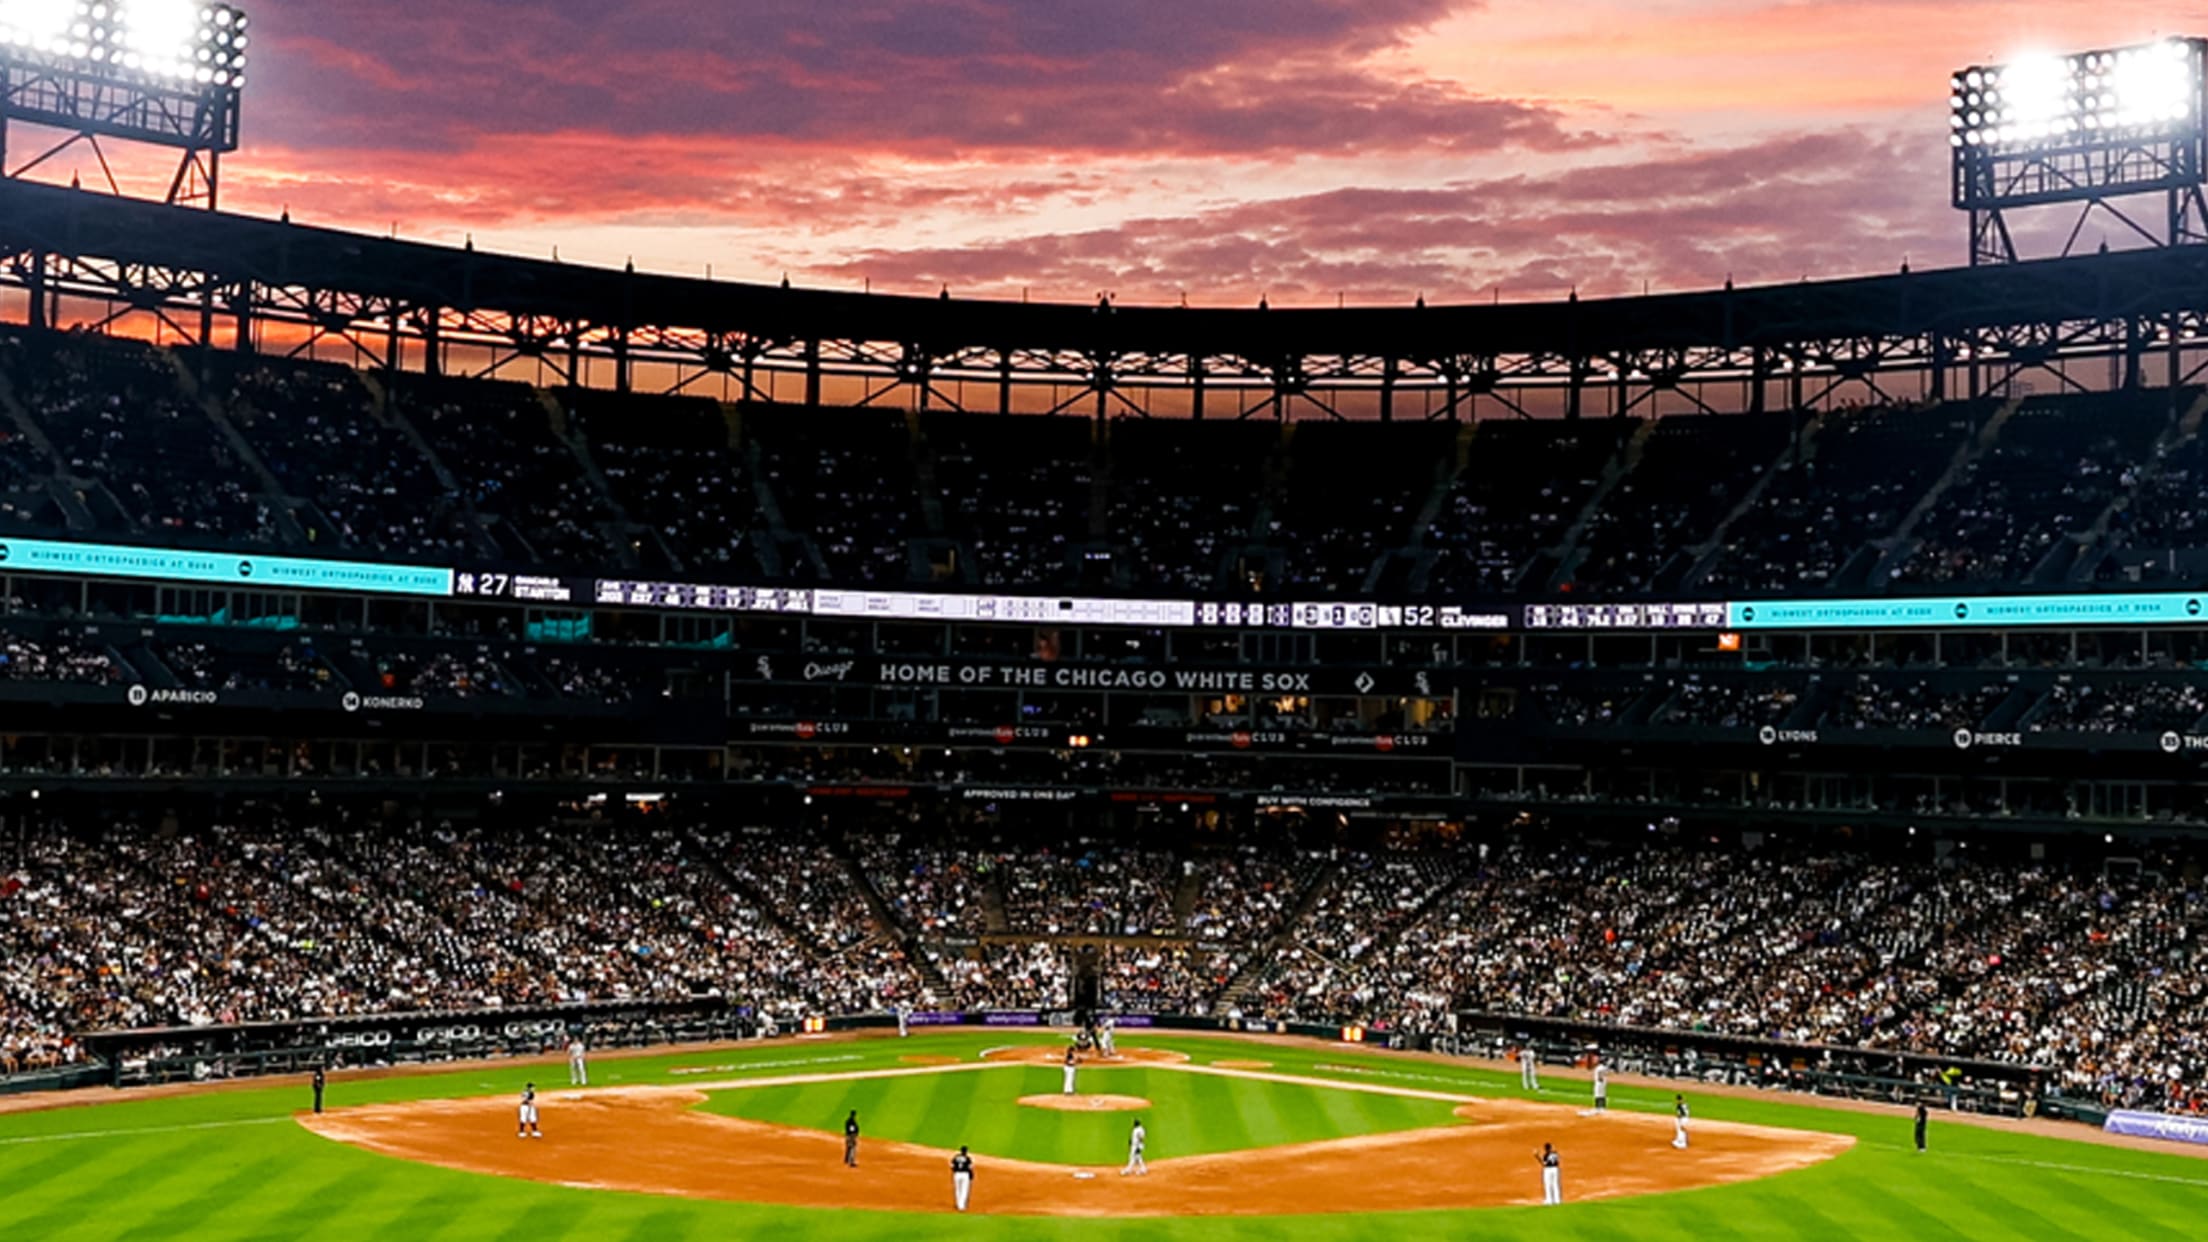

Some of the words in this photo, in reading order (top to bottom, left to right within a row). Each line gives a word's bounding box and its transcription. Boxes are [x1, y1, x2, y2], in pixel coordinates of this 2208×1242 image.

[479, 573, 508, 595] 27
[1404, 606, 1434, 626] 52
[881, 663, 950, 683] HOME
[959, 666, 992, 683] OF
[1000, 667, 1047, 685] THE
[1055, 668, 1166, 688] CHICAGO
[1175, 671, 1253, 689] WHITE
[1262, 673, 1310, 690] SOX
[151, 689, 217, 703] APARICIO
[363, 696, 424, 709] KONERKO
[1778, 730, 1818, 742] LYONS
[1974, 733, 2021, 745] PIERCE
[504, 1019, 565, 1039] GICO
